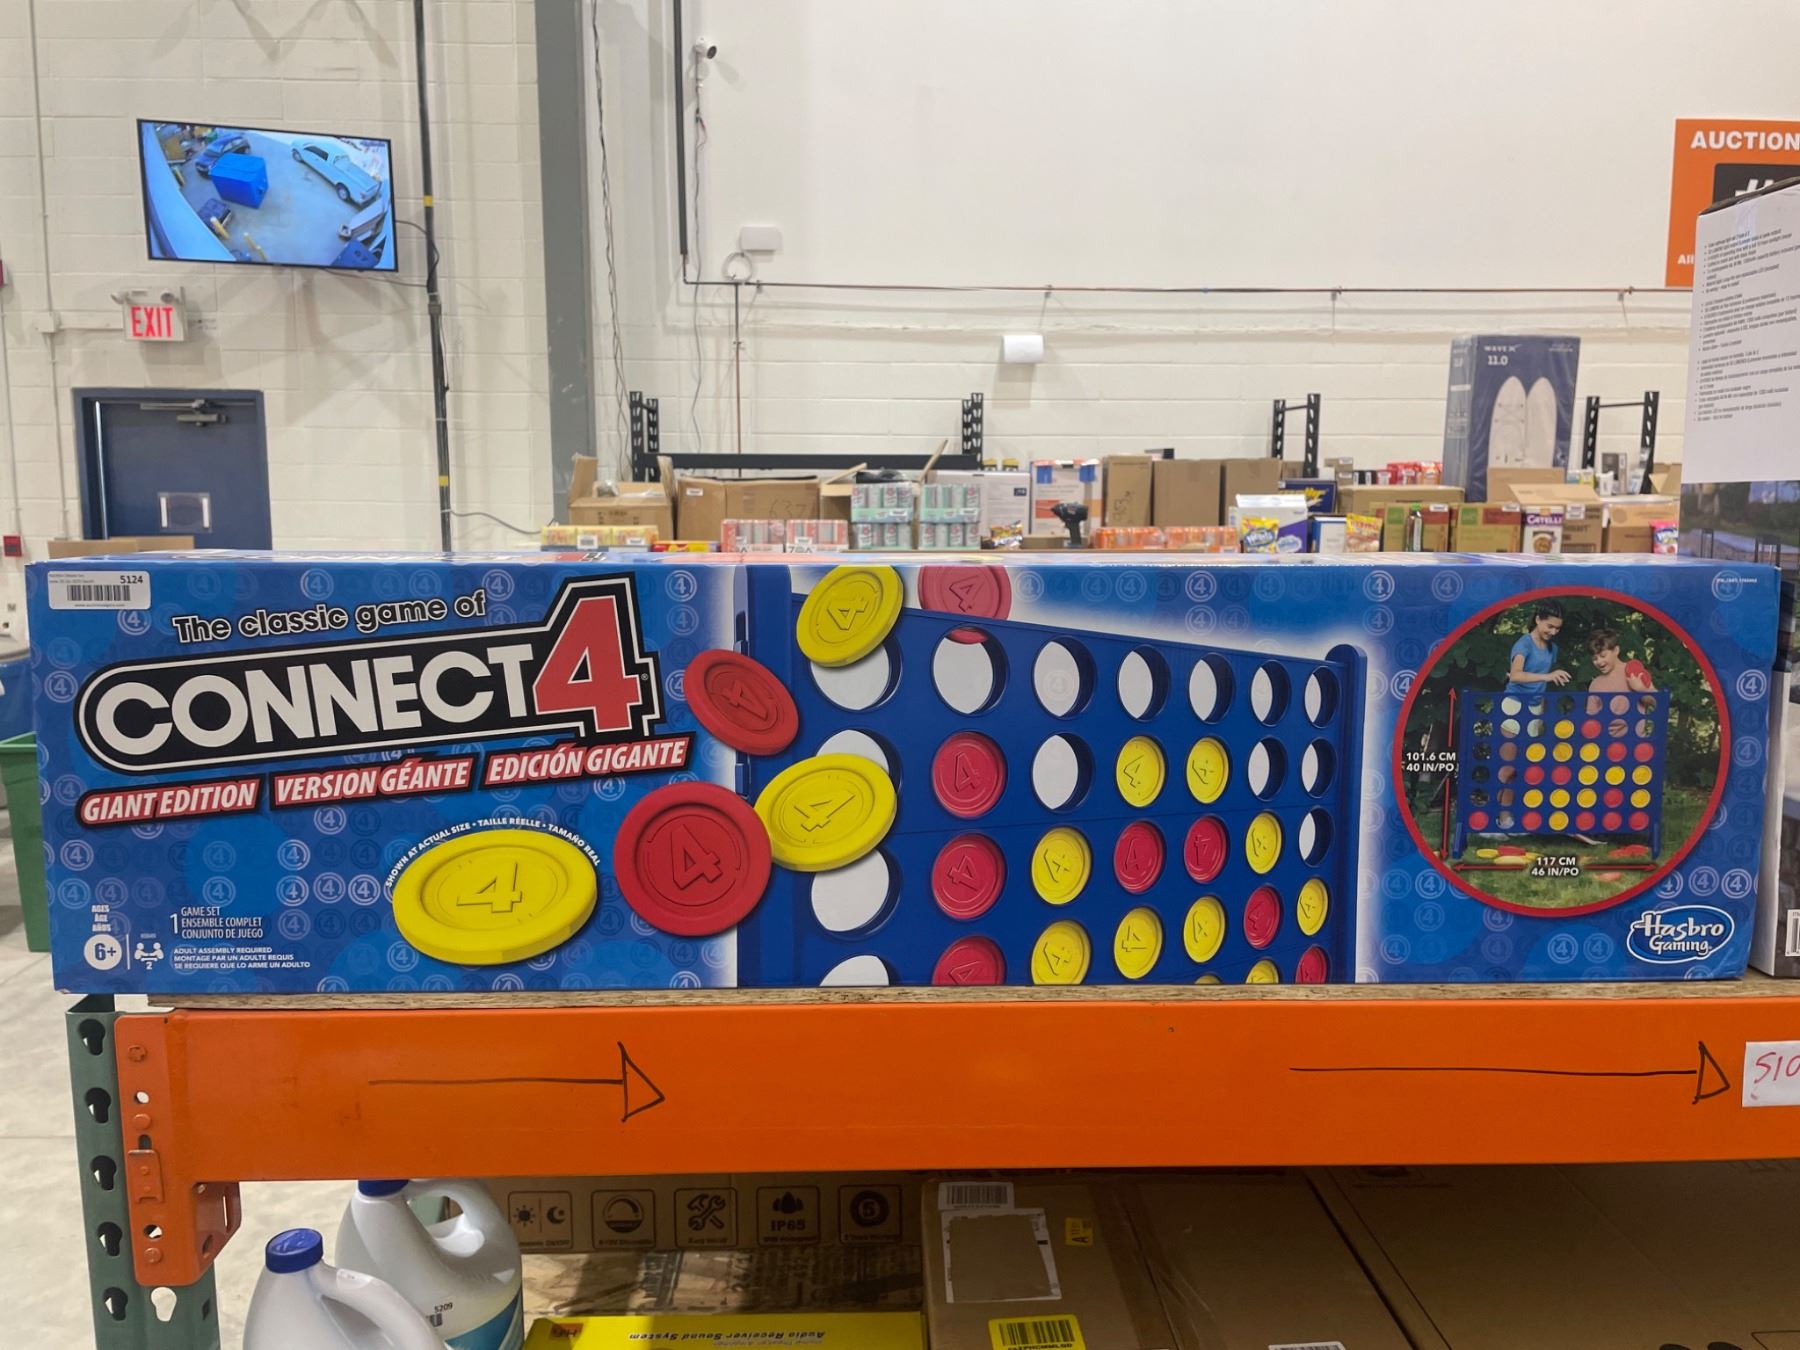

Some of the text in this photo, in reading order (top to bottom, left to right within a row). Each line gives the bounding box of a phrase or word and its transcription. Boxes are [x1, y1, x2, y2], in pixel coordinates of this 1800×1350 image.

[1690, 130, 1800, 150] AUCTION
[132, 305, 173, 338] EXIT
[1488, 355, 1509, 366] 11.0
[120, 575, 144, 584] 5124
[173, 589, 487, 644] The classic game of
[96, 595, 643, 756] CONNECT 4
[489, 740, 686, 782] EDICIÓN GIGANTE
[1406, 752, 1456, 761] 101.6 CM
[1406, 763, 1455, 772] 40 IN/PO
[276, 759, 470, 802] VERSION GÉANTE
[83, 782, 257, 822] GIANT EDITION
[477, 817, 541, 828] TAILLE RÉELLE
[385, 822, 471, 887] SHOWN AT ACTUAL SIZE
[584, 844, 601, 866] REAL
[1536, 857, 1576, 866] 117 CM
[1531, 867, 1579, 876] 46 IN/PO
[180, 906, 220, 917] GAME SET
[169, 913, 179, 934] 1
[181, 916, 262, 928] ENSEMBLE COMPLET
[1634, 914, 1724, 941] Hasbro
[181, 928, 263, 939] CONJUNTO DE JUEGO
[94, 942, 117, 961] 6+
[1649, 935, 1709, 955] Gaming
[145, 961, 153, 970] 2
[434, 1302, 454, 1313] 5209
[628, 1331, 825, 1343] Audio Receiver Sound System
